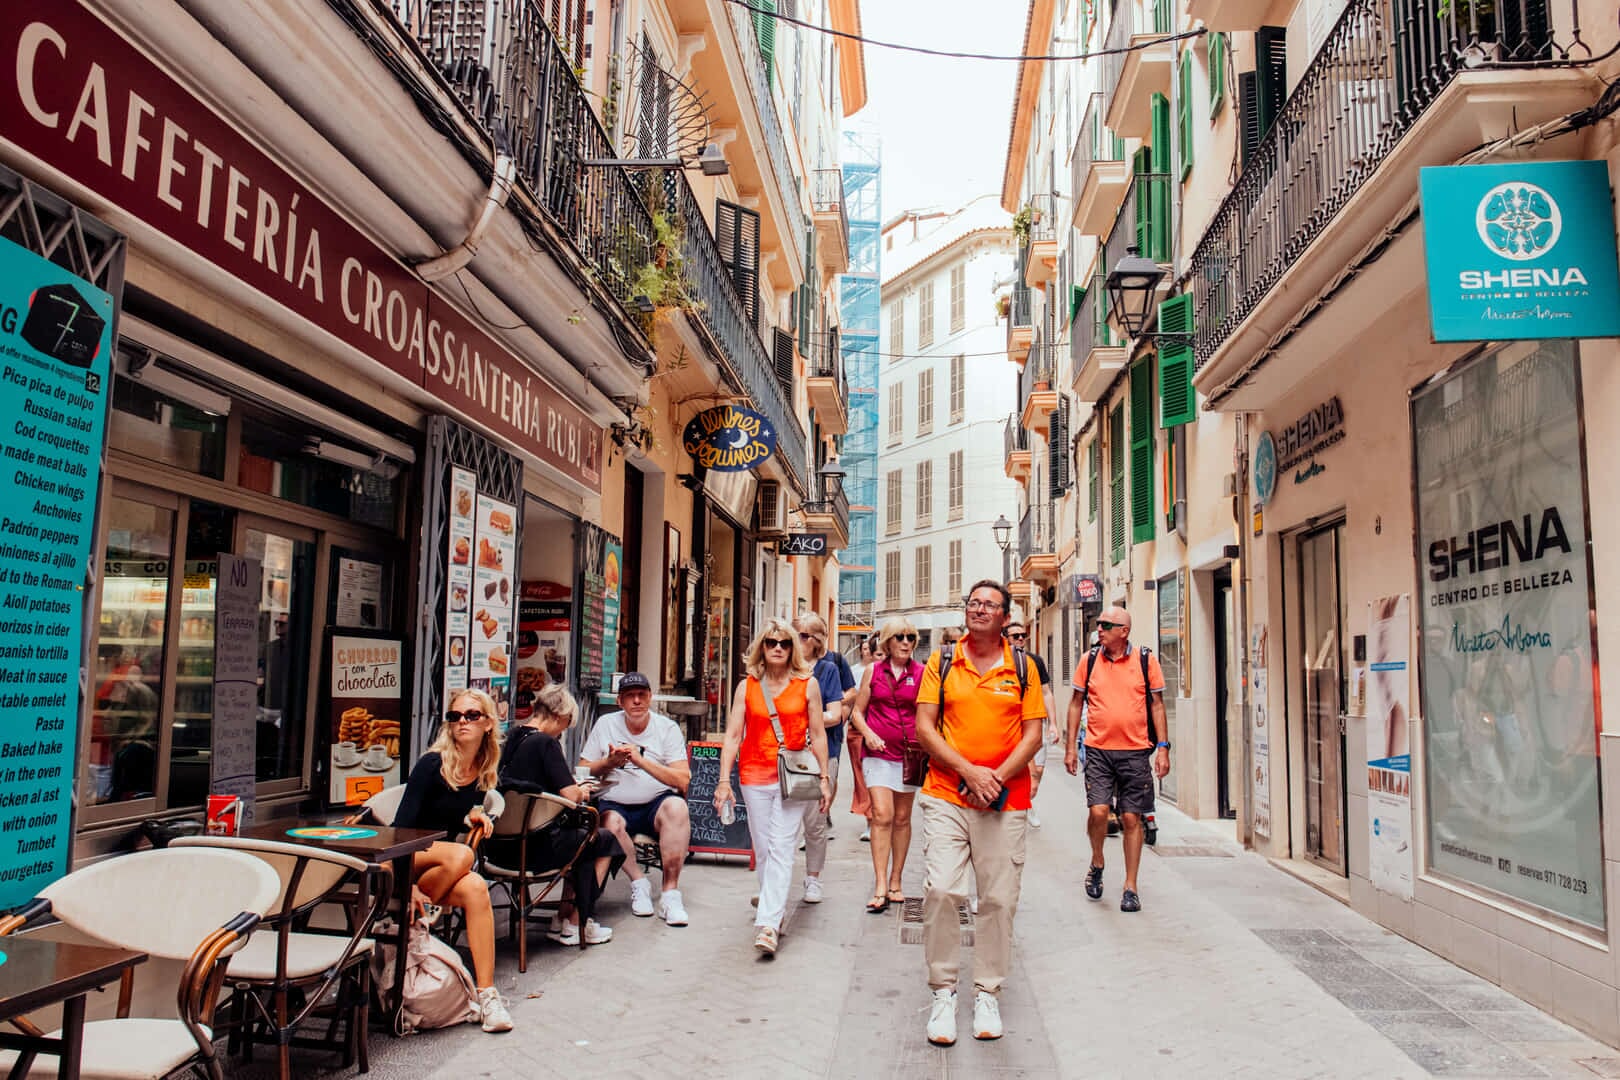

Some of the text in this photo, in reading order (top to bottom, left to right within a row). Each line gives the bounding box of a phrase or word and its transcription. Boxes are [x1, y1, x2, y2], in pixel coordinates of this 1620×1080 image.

[16, 21, 324, 303] CAFETERÍA
[340, 256, 541, 443] CROASSANTERÍA
[1460, 267, 1588, 289] SHENA
[3, 365, 94, 411] Pica pica de pulpo
[24, 398, 93, 433] Russian salad
[1278, 395, 1344, 458] SHENA
[15, 420, 90, 455] Cod croquettes
[5, 446, 35, 463] made
[37, 454, 63, 471] meat
[64, 456, 88, 478] balls
[14, 470, 85, 502] Chicken wings
[32, 499, 82, 523] Anchovies
[1, 517, 80, 545] Padrón peppers
[782, 537, 823, 551] RAKO
[1429, 506, 1571, 582] SHENA
[41, 550, 52, 564] al
[52, 552, 77, 568] ajillo
[9, 570, 21, 584] to
[22, 571, 39, 586] the
[41, 574, 73, 591] Roman
[230, 560, 248, 587] NO
[1431, 569, 1573, 606] CENTRO DE BELLEZA
[4, 594, 72, 615] Aioli potatoes
[0, 619, 70, 637] orizos in cider
[36, 645, 69, 660] tortilla
[337, 647, 398, 665] CHURROS
[26, 669, 36, 684] in
[38, 672, 68, 683] sauce
[337, 667, 397, 691] chocolate
[352, 664, 366, 674] con
[31, 693, 67, 707] omelet
[35, 716, 65, 731] Pasta
[1, 740, 63, 758] Baked hake
[4, 767, 15, 783] in
[17, 765, 35, 781] the
[37, 766, 62, 779] oven
[30, 787, 42, 804] al
[43, 786, 60, 803] ast
[3, 812, 58, 832] with onion
[16, 834, 57, 854] Tumbet
[0, 861, 55, 882] ourgettes
[1517, 863, 1544, 880] reservas
[1544, 869, 1557, 887] 971
[1558, 873, 1573, 890] 728
[1573, 877, 1588, 894] 253
